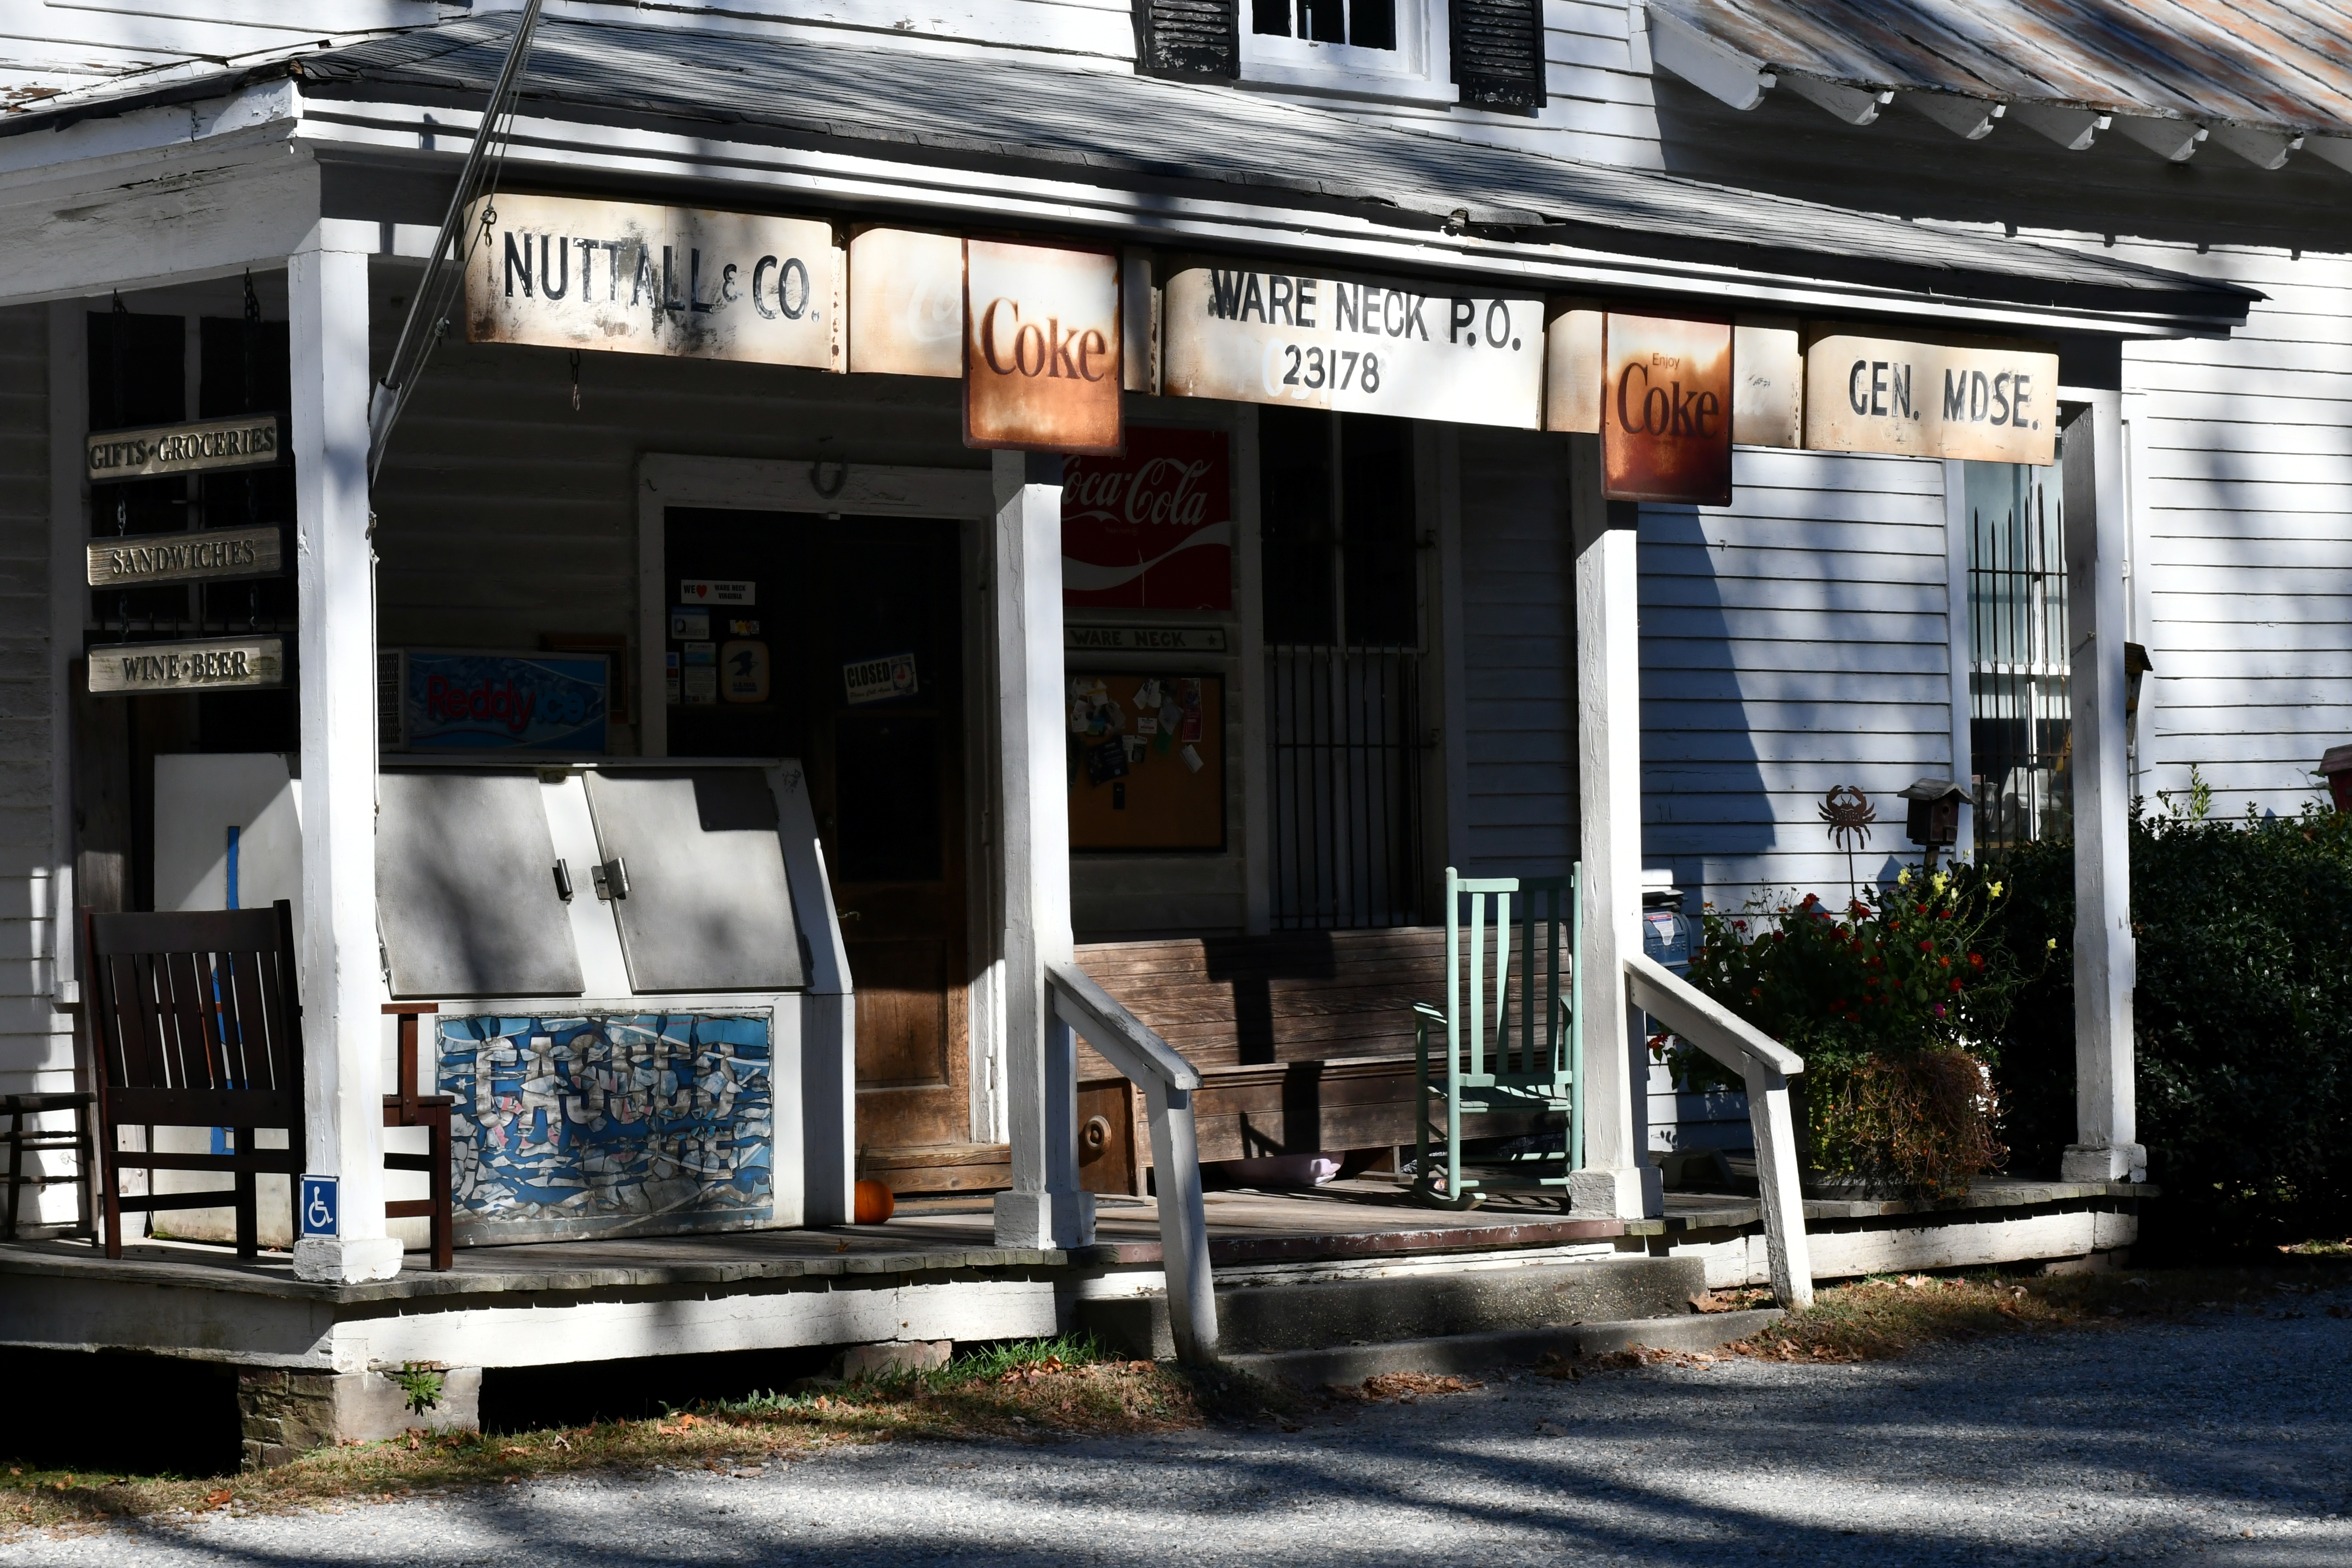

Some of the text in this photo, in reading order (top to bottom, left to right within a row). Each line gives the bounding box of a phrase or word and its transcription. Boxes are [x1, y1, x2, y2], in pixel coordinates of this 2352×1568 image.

[504, 231, 821, 323] NUTTALL & CO.
[1210, 269, 1522, 351] WARE NECK P.O.
[980, 297, 1106, 382] Coke
[1652, 352, 1680, 369] Enjoy
[1283, 344, 1380, 394] 23178
[1617, 362, 1719, 439] Coke
[1849, 359, 2040, 431] GEN. MDSE.
[90, 427, 276, 470] GIFTS GROCERIES
[111, 539, 255, 575] SANDWICHES
[683, 585, 696, 594] WE
[1070, 629, 1186, 648] WARE NECK
[122, 651, 250, 681] WINE BEER
[847, 662, 890, 688] CLOSED
[427, 675, 536, 732] Reddy
